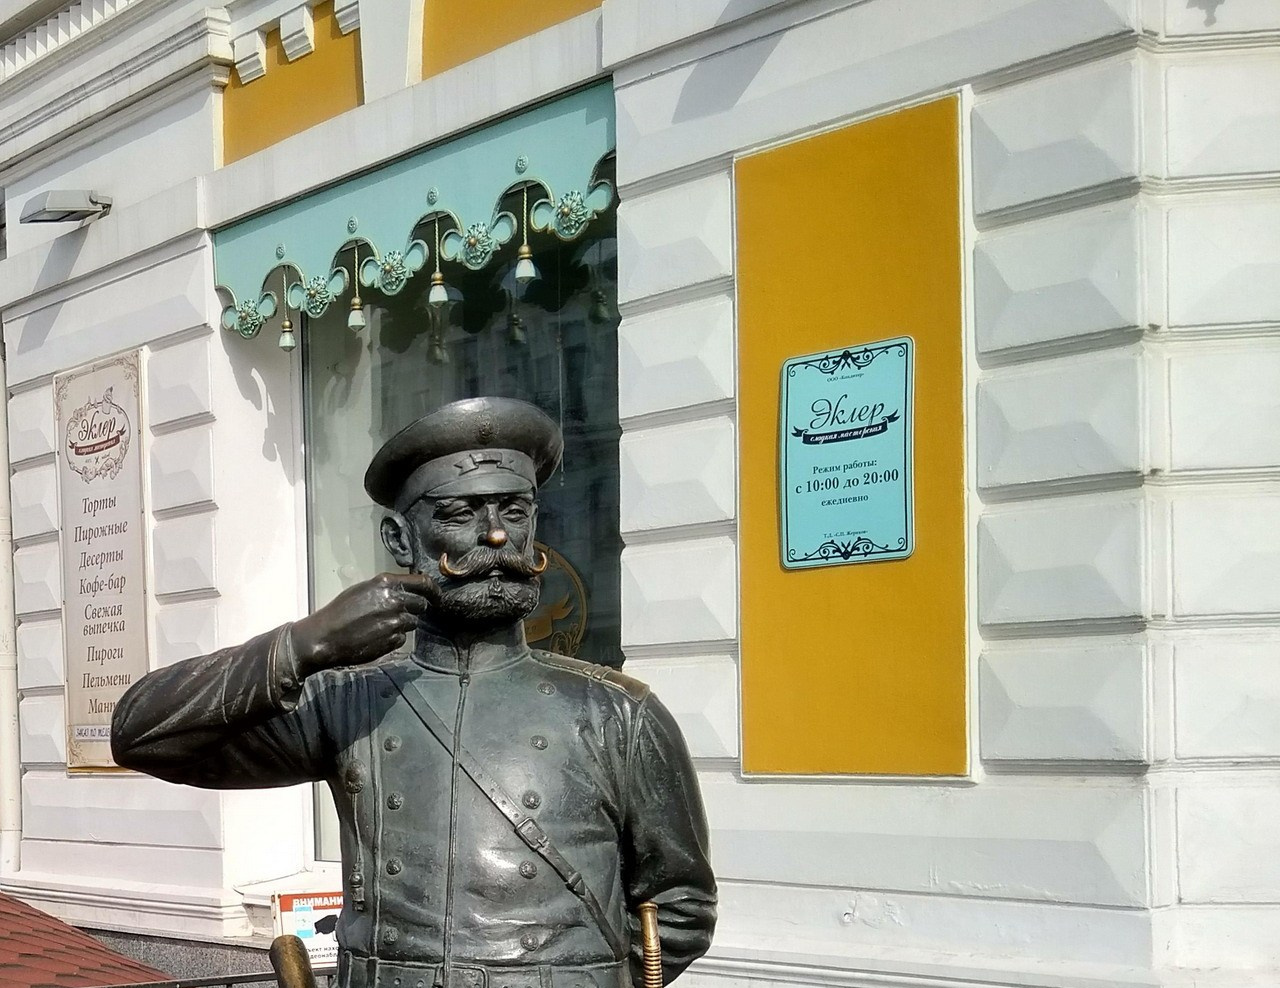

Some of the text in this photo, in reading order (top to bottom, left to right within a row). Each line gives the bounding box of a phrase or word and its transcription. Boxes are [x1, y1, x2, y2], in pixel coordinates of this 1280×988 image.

[810, 394, 885, 430] Эклер
[78, 410, 116, 441] Эклер
[813, 459, 877, 475] Режим работы:
[795, 468, 899, 494] с 10:00 до 20:00
[82, 496, 117, 517] Торты
[821, 494, 869, 506] ежедневно
[74, 521, 128, 545] Пирожные
[79, 550, 124, 572] Десерты
[80, 573, 126, 597] Кофе-бар
[85, 603, 123, 620] Свежая
[83, 620, 125, 636] выпечка
[87, 645, 123, 666] Пироги
[82, 673, 131, 689] Пельмени
